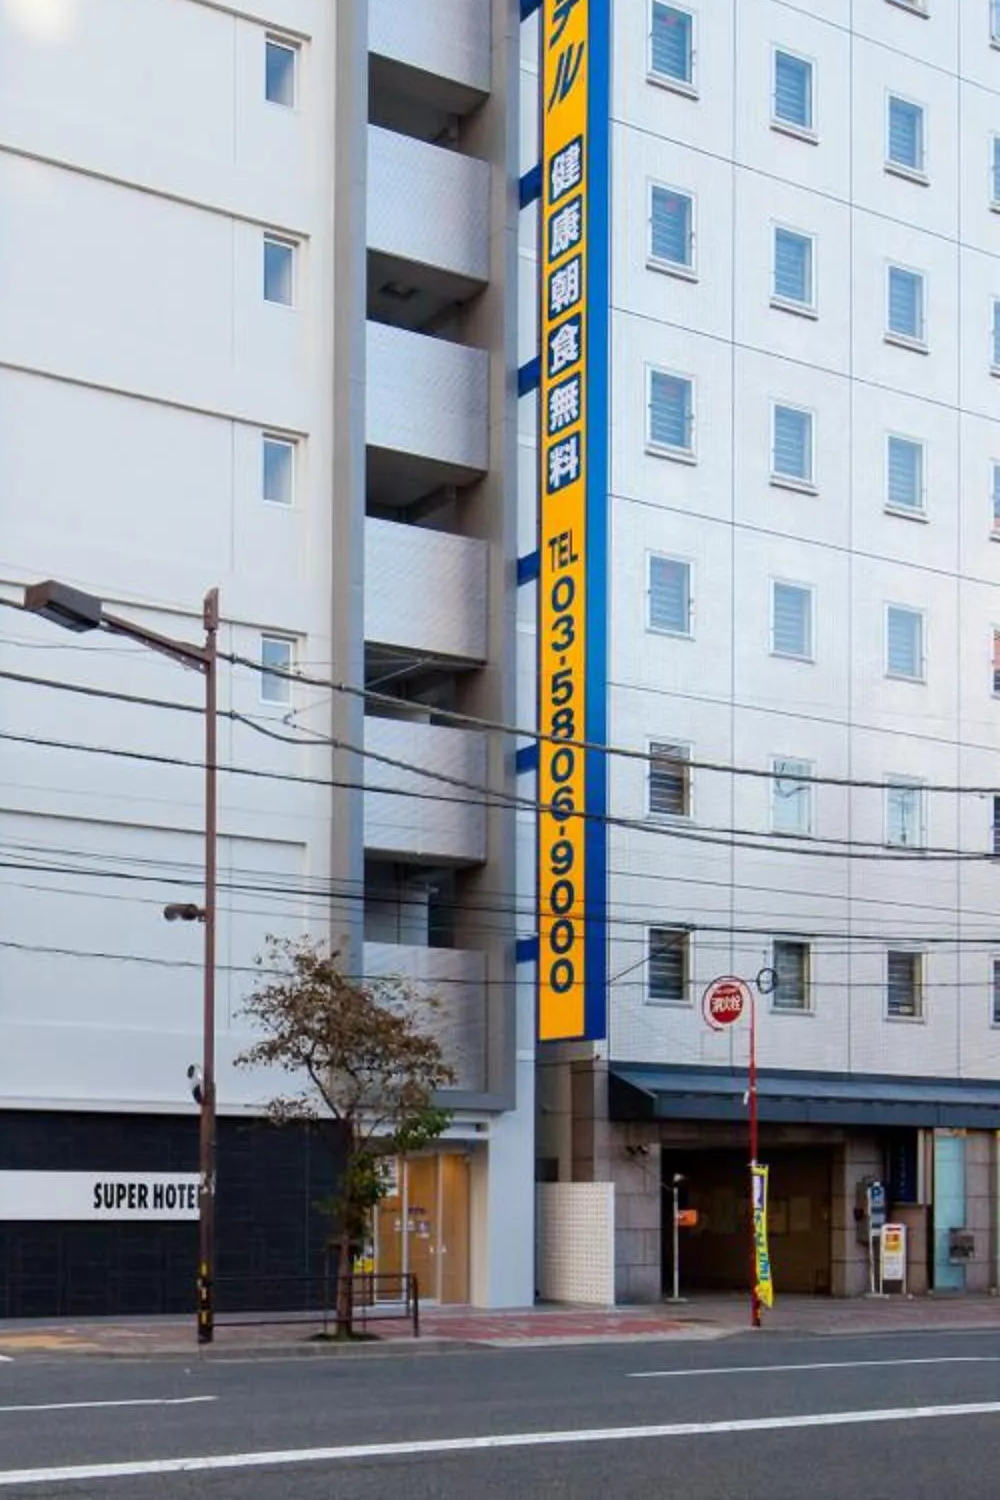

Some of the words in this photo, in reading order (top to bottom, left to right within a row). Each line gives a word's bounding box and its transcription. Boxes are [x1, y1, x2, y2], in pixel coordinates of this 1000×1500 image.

[549, 140, 583, 491] 健康朝食無料
[93, 1183, 149, 1209] SUPER
